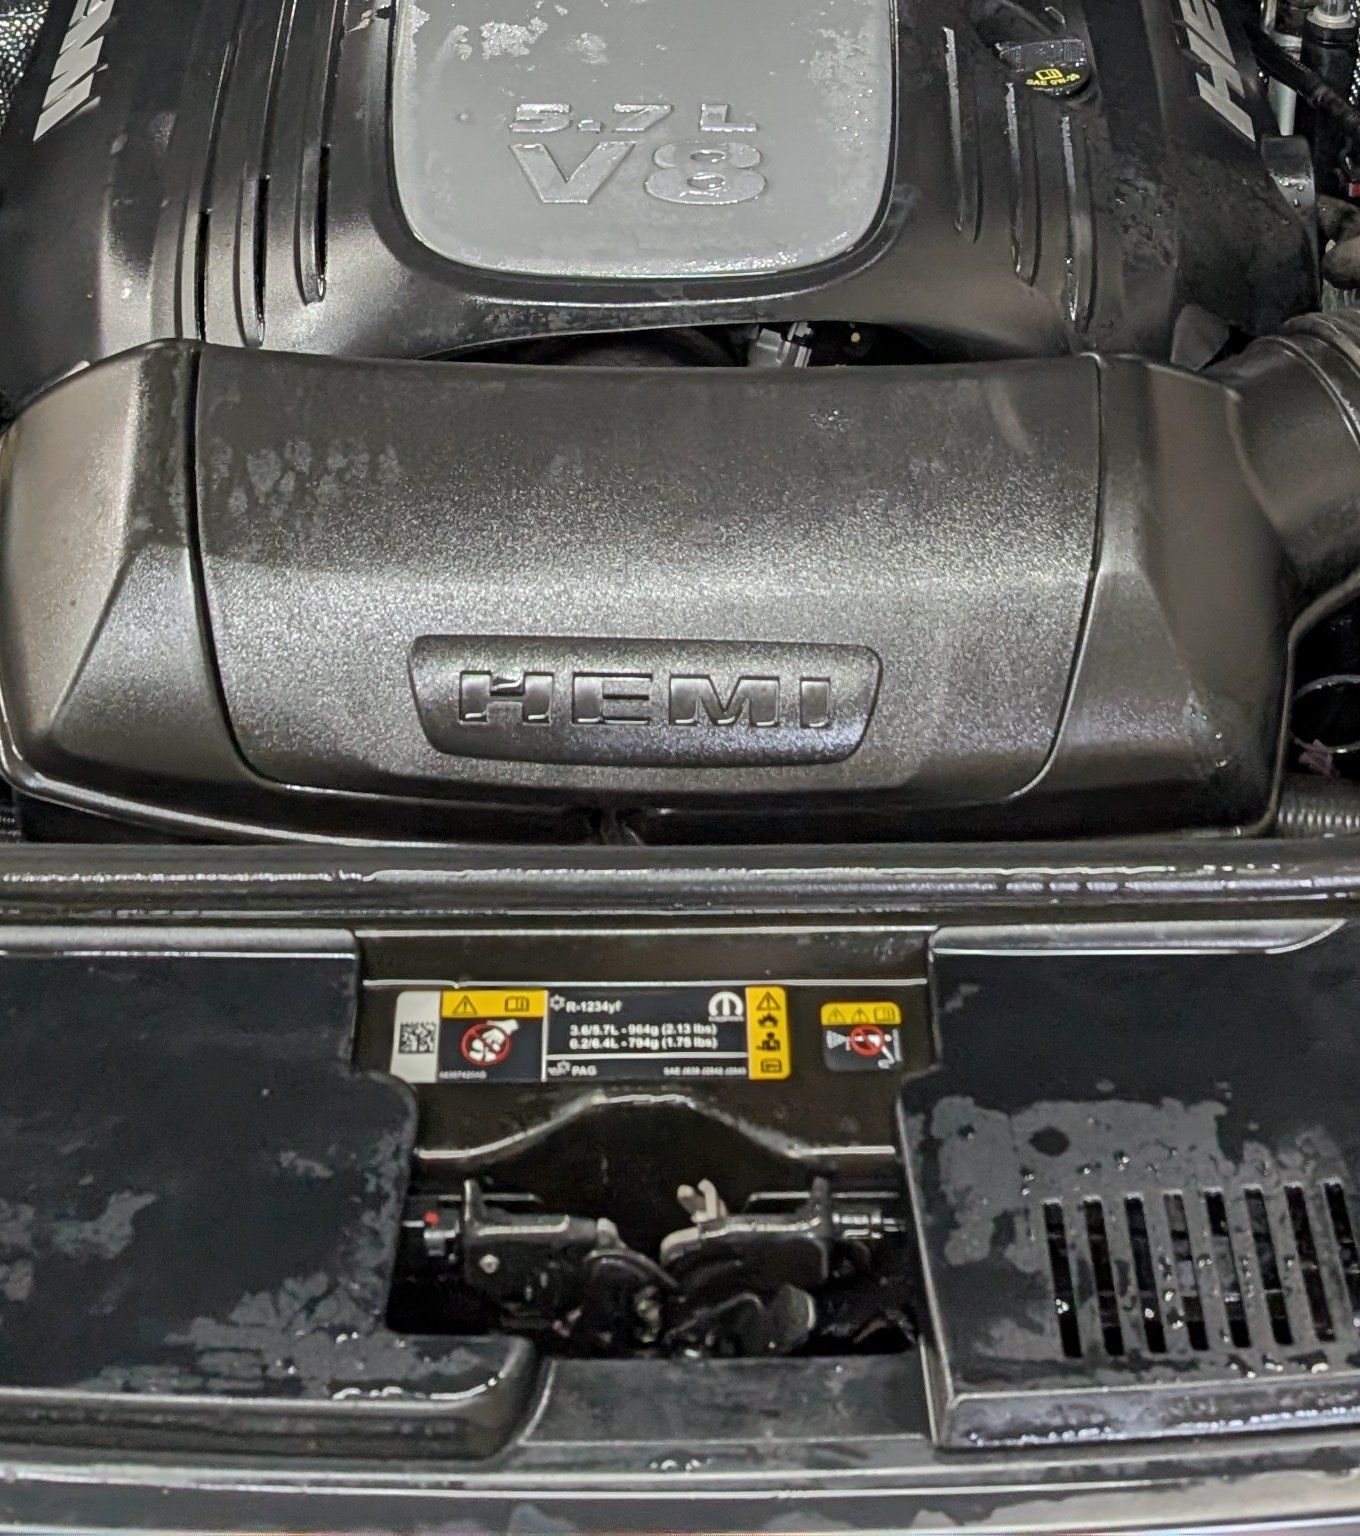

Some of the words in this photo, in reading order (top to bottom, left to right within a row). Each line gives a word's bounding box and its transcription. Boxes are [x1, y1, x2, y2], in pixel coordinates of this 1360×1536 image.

[508, 140, 768, 205] V8
[458, 669, 833, 730] HEMI
[571, 1064, 598, 1077] PAG
